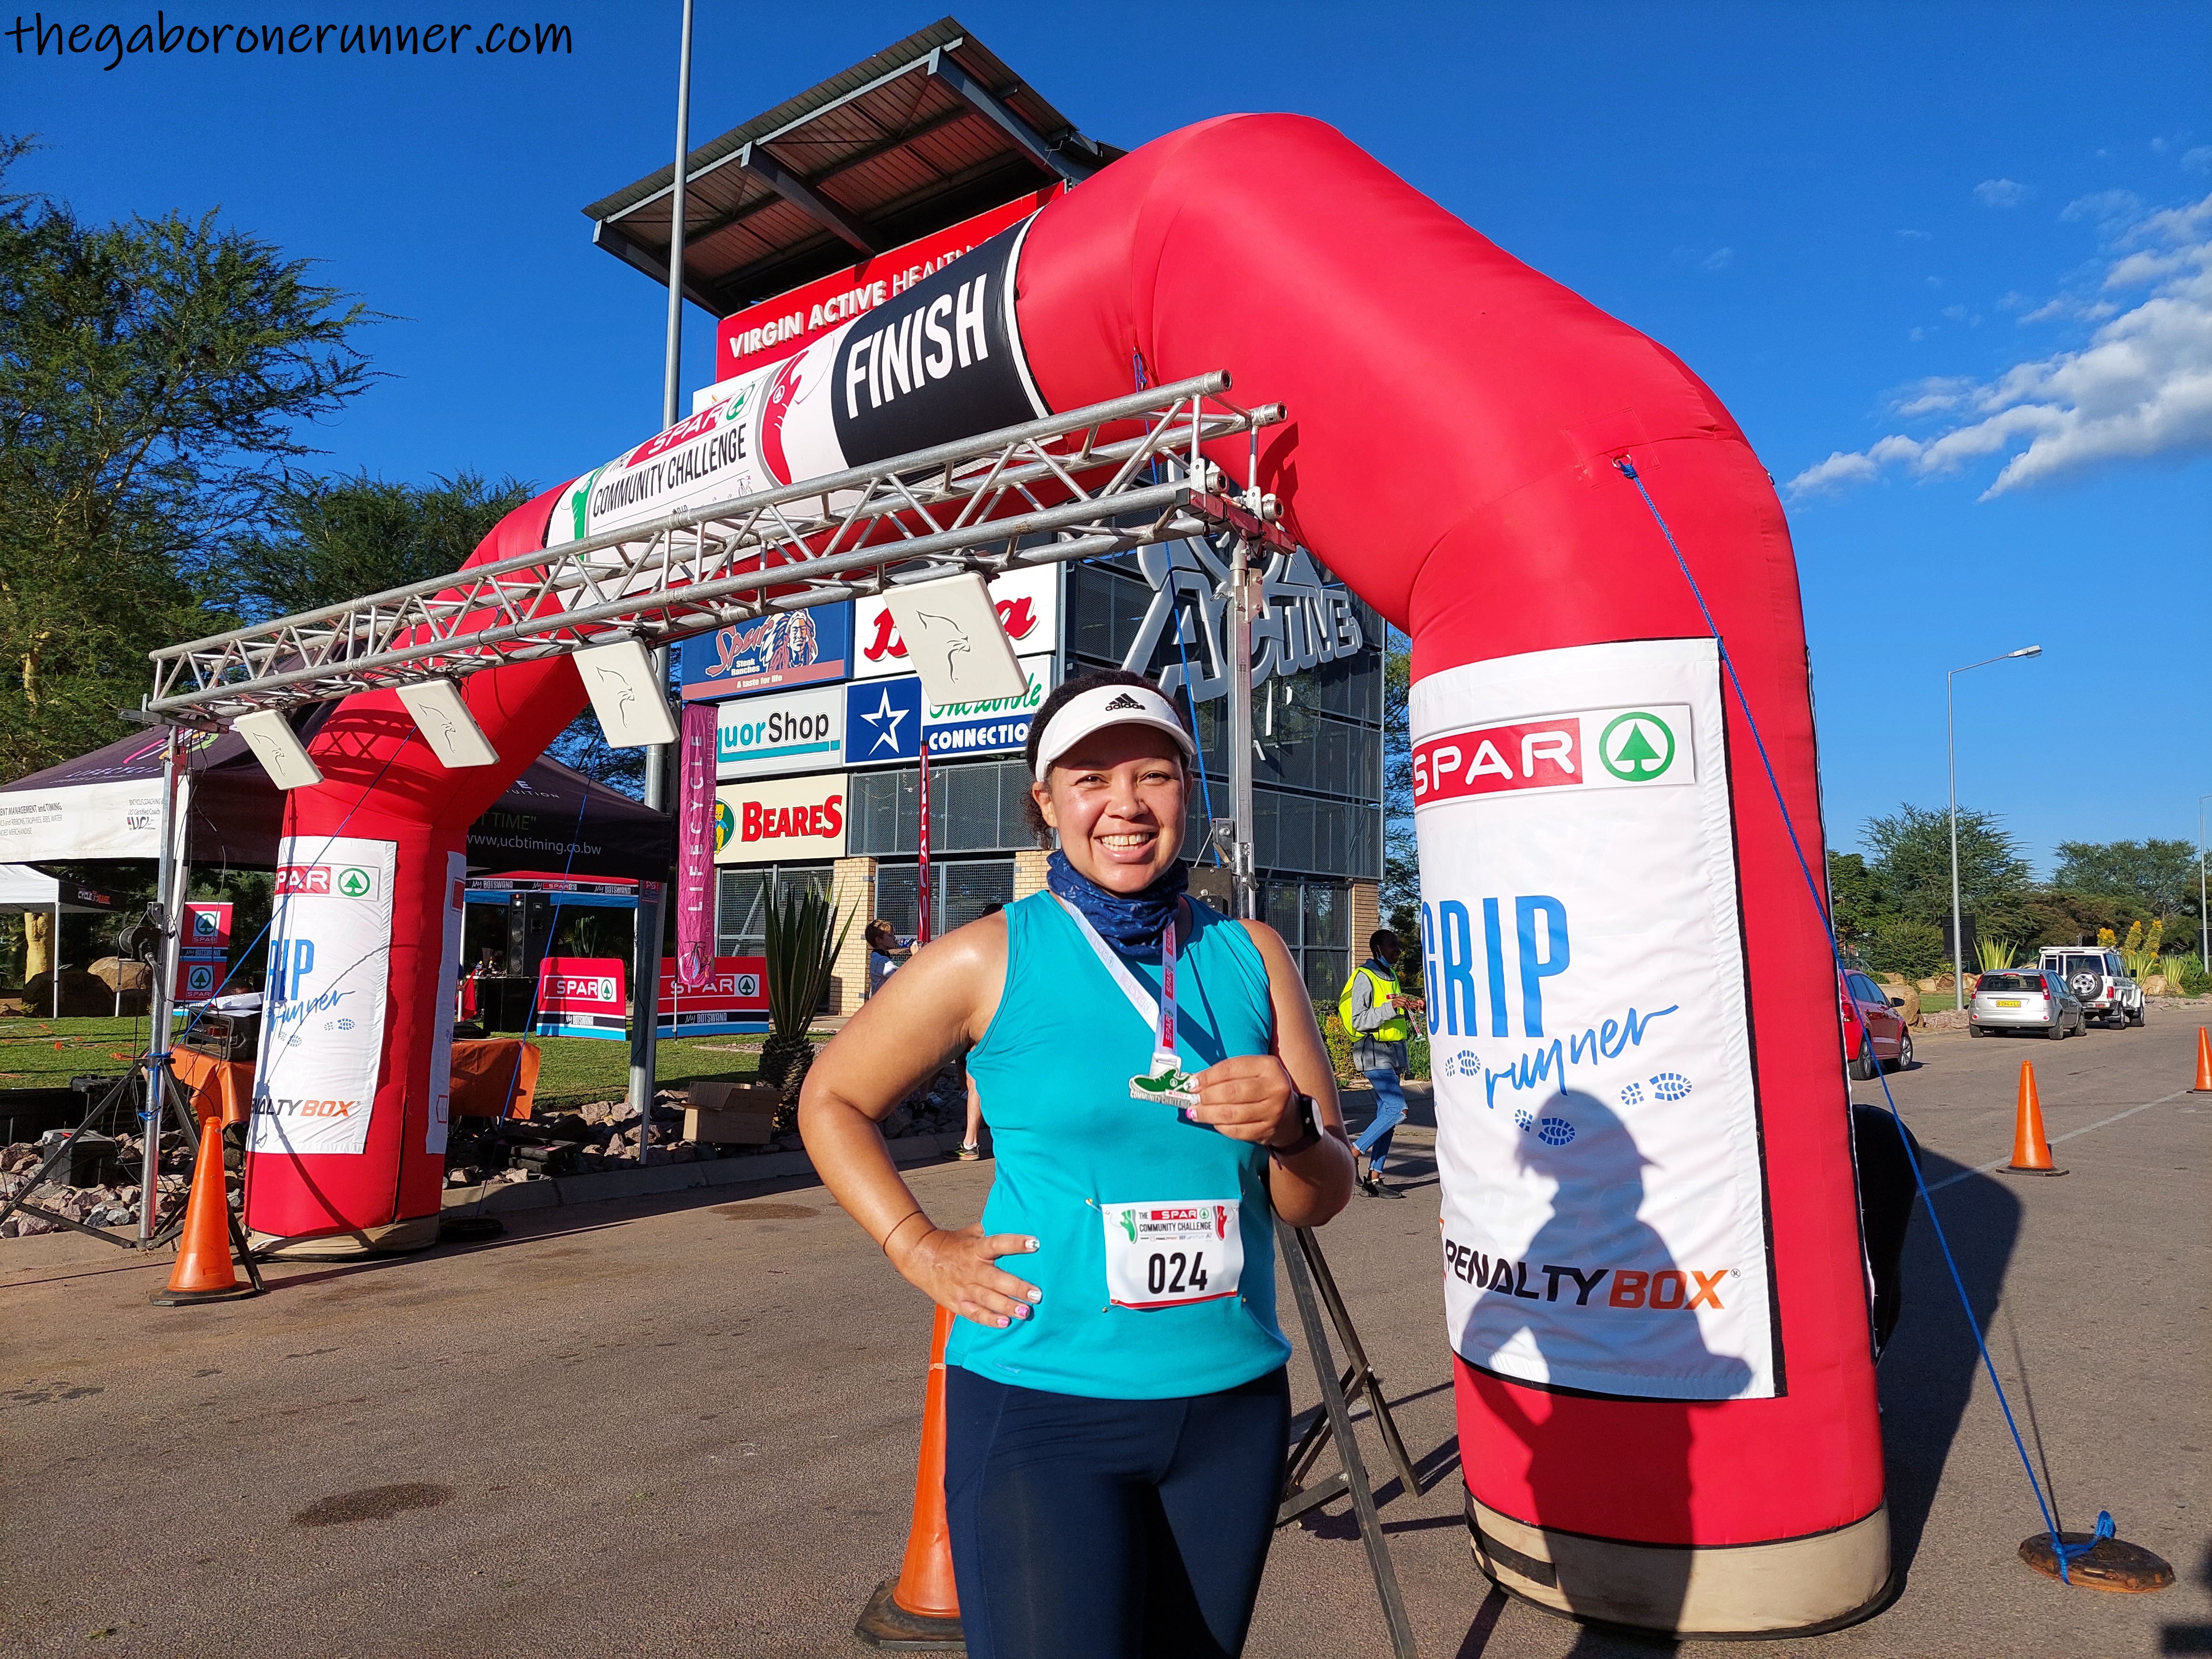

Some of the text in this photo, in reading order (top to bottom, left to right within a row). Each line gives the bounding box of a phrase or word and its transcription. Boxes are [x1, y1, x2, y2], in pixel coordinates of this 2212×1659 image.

[729, 311, 804, 360] VIRGIN
[807, 280, 887, 332] ACTIVE
[846, 273, 989, 420] FINISH
[648, 401, 729, 455] SPAR
[593, 423, 747, 518] COMMUNITY CHALLENGE
[706, 619, 774, 677] Spur
[736, 658, 755, 668] Steak
[731, 665, 760, 676] Ranches
[742, 678, 759, 687] taste
[760, 676, 770, 685] for
[771, 674, 783, 683] life
[929, 723, 1029, 750] CONNECTIO
[1414, 730, 1575, 797] SPAR
[9, 805, 37, 815] MANAGEMENT
[38, 804, 46, 812] and
[45, 802, 62, 812] TIMING
[688, 735, 704, 911] LIFECYCLE
[741, 795, 842, 842] BEARES
[276, 870, 328, 890] PAR
[483, 880, 513, 889] BOTSWANA
[605, 886, 631, 895] BOTSWANA
[265, 939, 314, 1001] RIP
[1421, 895, 1571, 1038] GRIP
[556, 980, 598, 996] SPAR
[271, 990, 355, 1032] runner
[573, 1015, 594, 1026] BOTSWANA
[685, 1012, 727, 1024] My BOTSWANA
[1485, 1004, 1679, 1109] runner
[1139, 1221, 1212, 1232] COMMUNITY CHALLENGE
[1161, 1210, 1197, 1219] SPAR
[1148, 1251, 1208, 1294] 024
